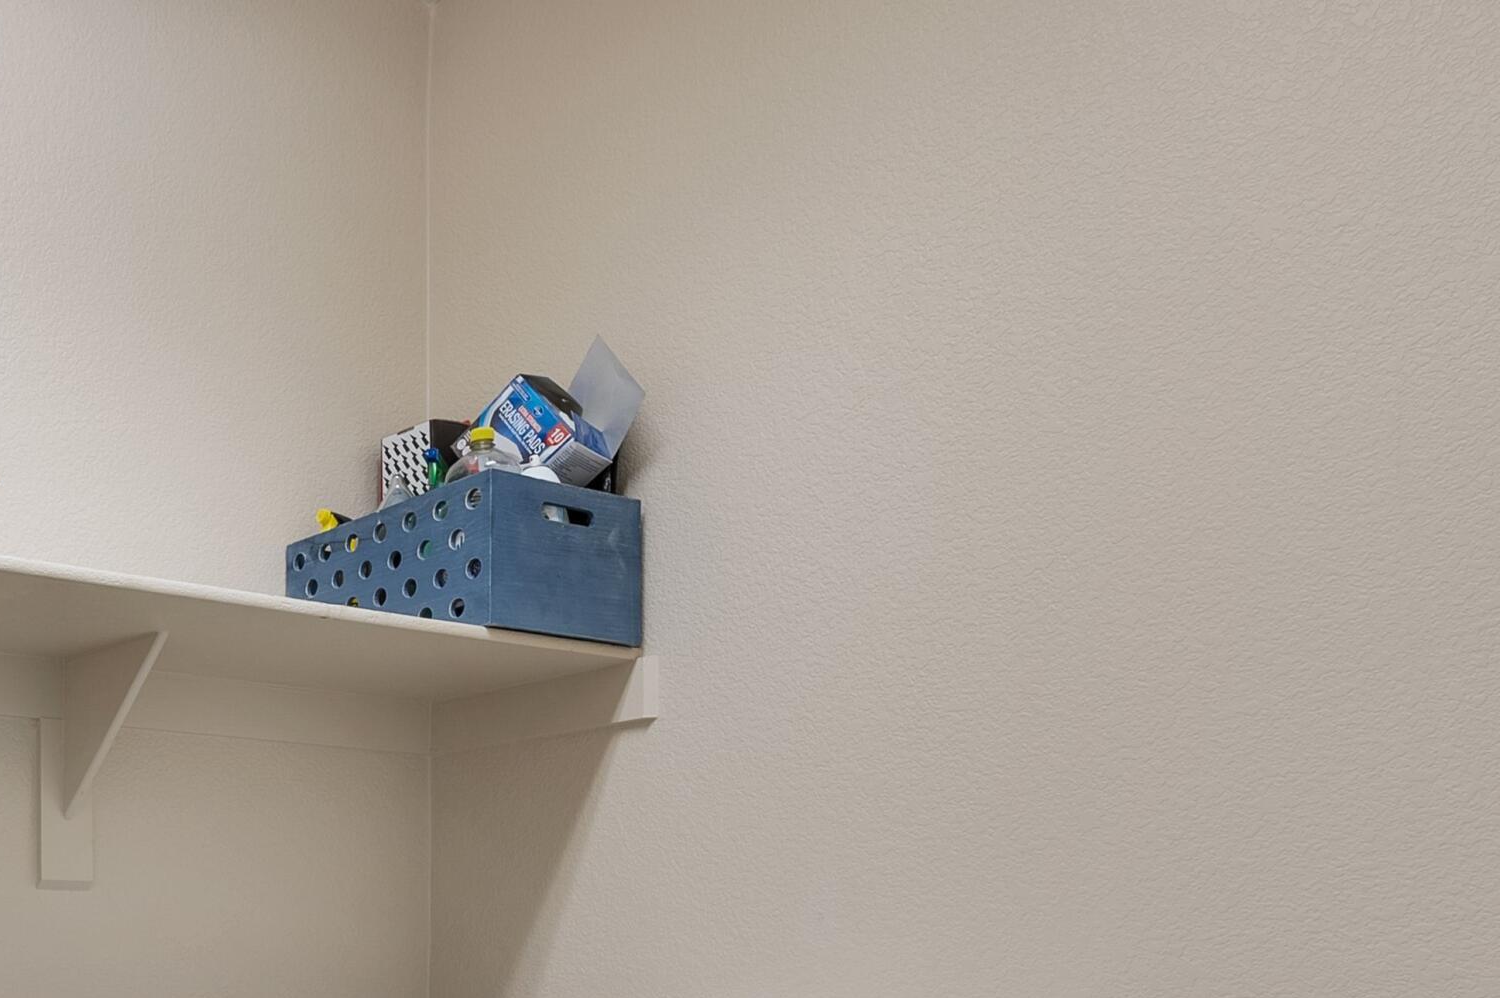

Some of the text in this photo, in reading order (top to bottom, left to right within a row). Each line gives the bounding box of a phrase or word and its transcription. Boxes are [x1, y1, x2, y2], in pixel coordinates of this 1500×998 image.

[500, 400, 530, 437] ERASING
[523, 430, 546, 454] PADS
[551, 428, 565, 443] 10
